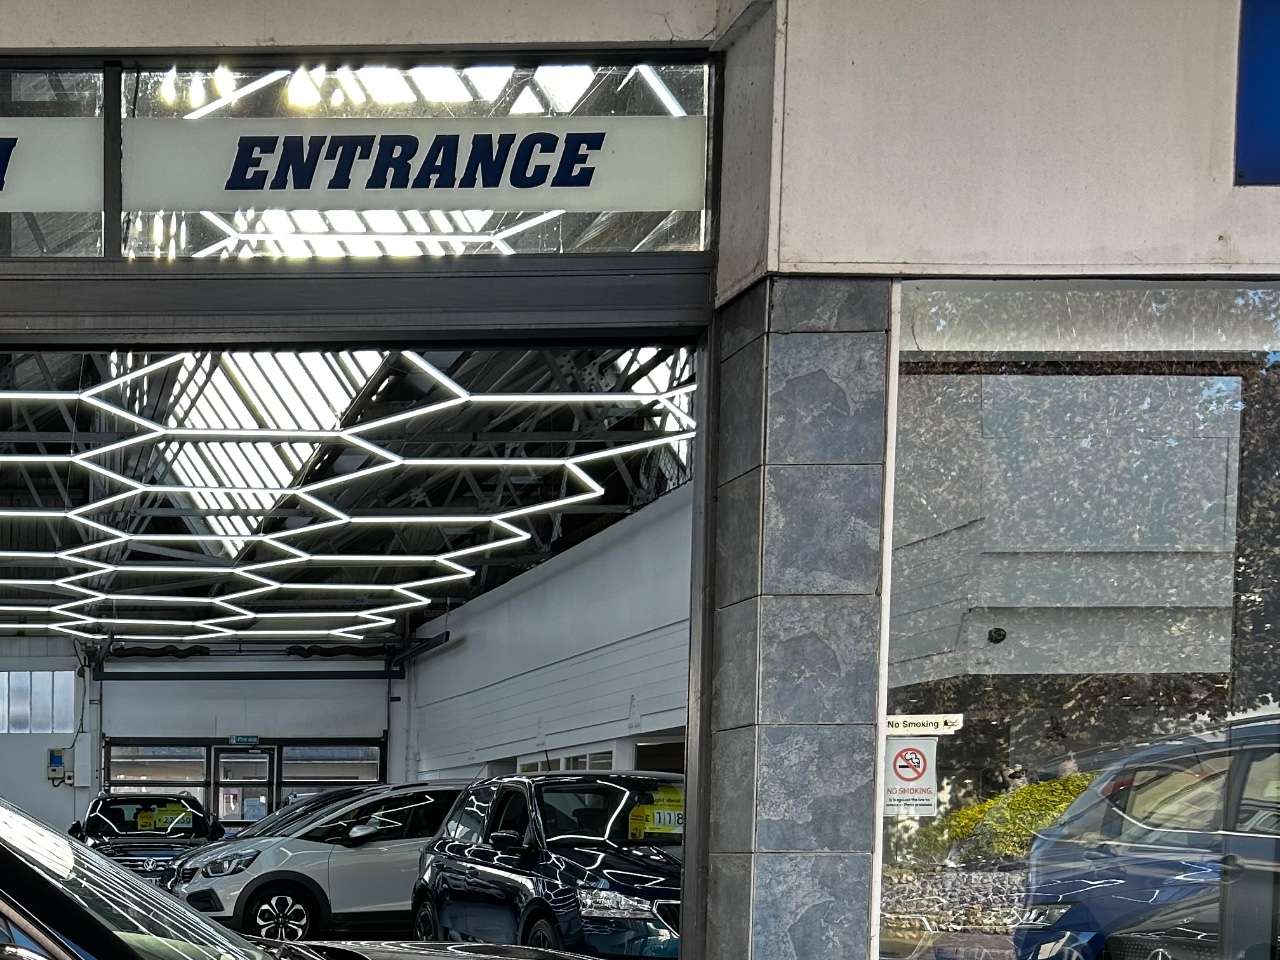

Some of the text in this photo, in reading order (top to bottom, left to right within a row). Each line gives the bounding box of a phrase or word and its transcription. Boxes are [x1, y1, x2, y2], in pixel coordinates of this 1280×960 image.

[224, 131, 606, 191] ENTRANCE
[887, 720, 939, 729] No Smoking
